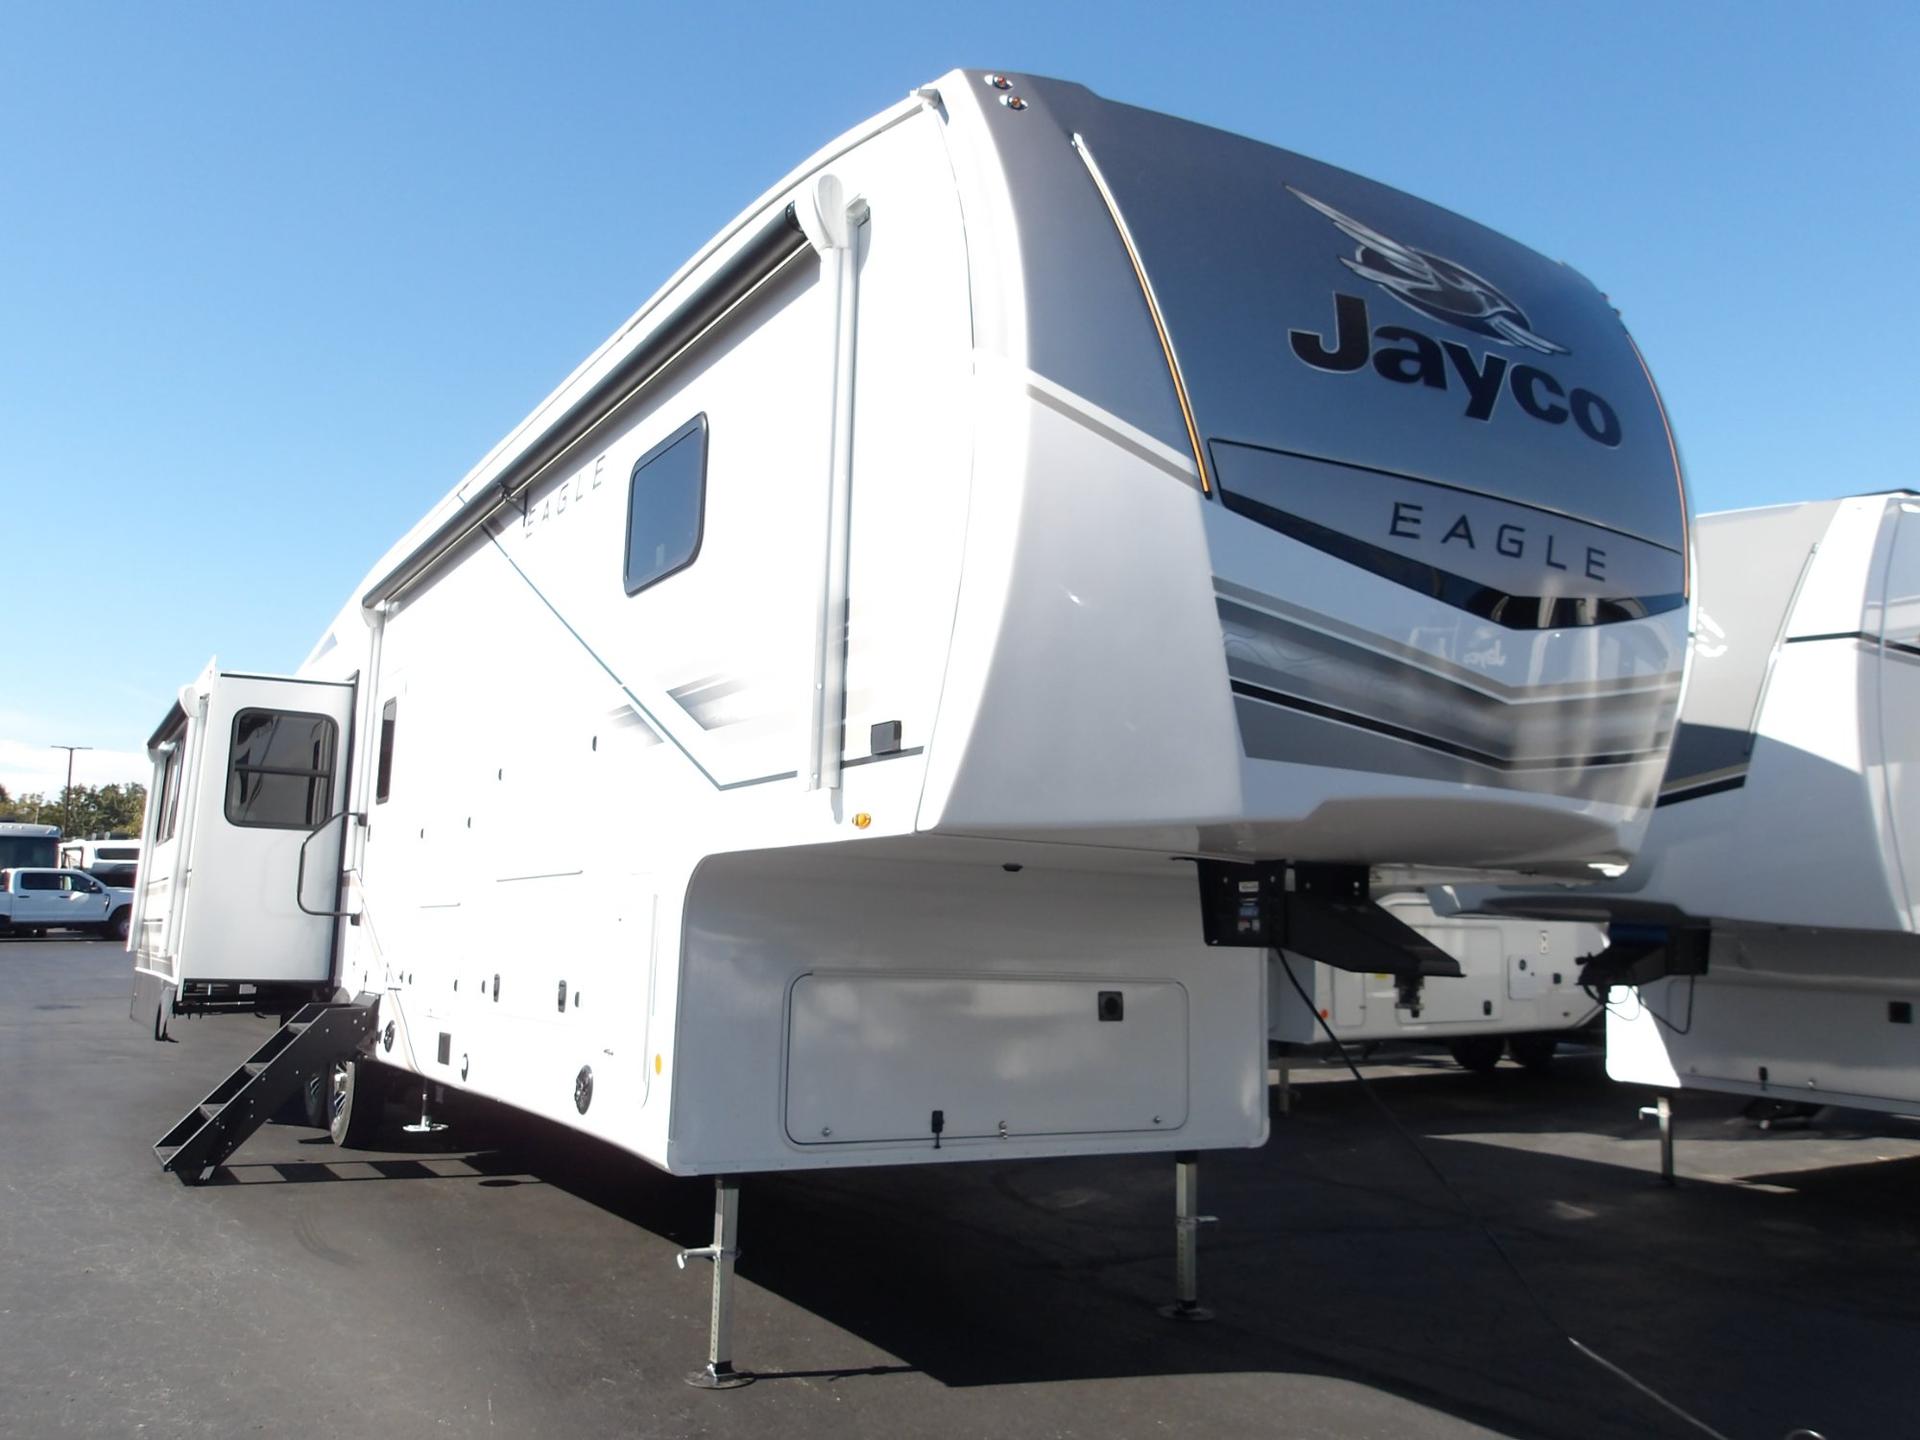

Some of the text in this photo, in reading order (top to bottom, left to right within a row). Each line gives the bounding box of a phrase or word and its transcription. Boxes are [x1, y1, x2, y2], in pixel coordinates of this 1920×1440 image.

[1288, 290, 1622, 449] Jayco
[525, 455, 606, 538] EAGLE
[1389, 501, 1608, 582] EAGLE
